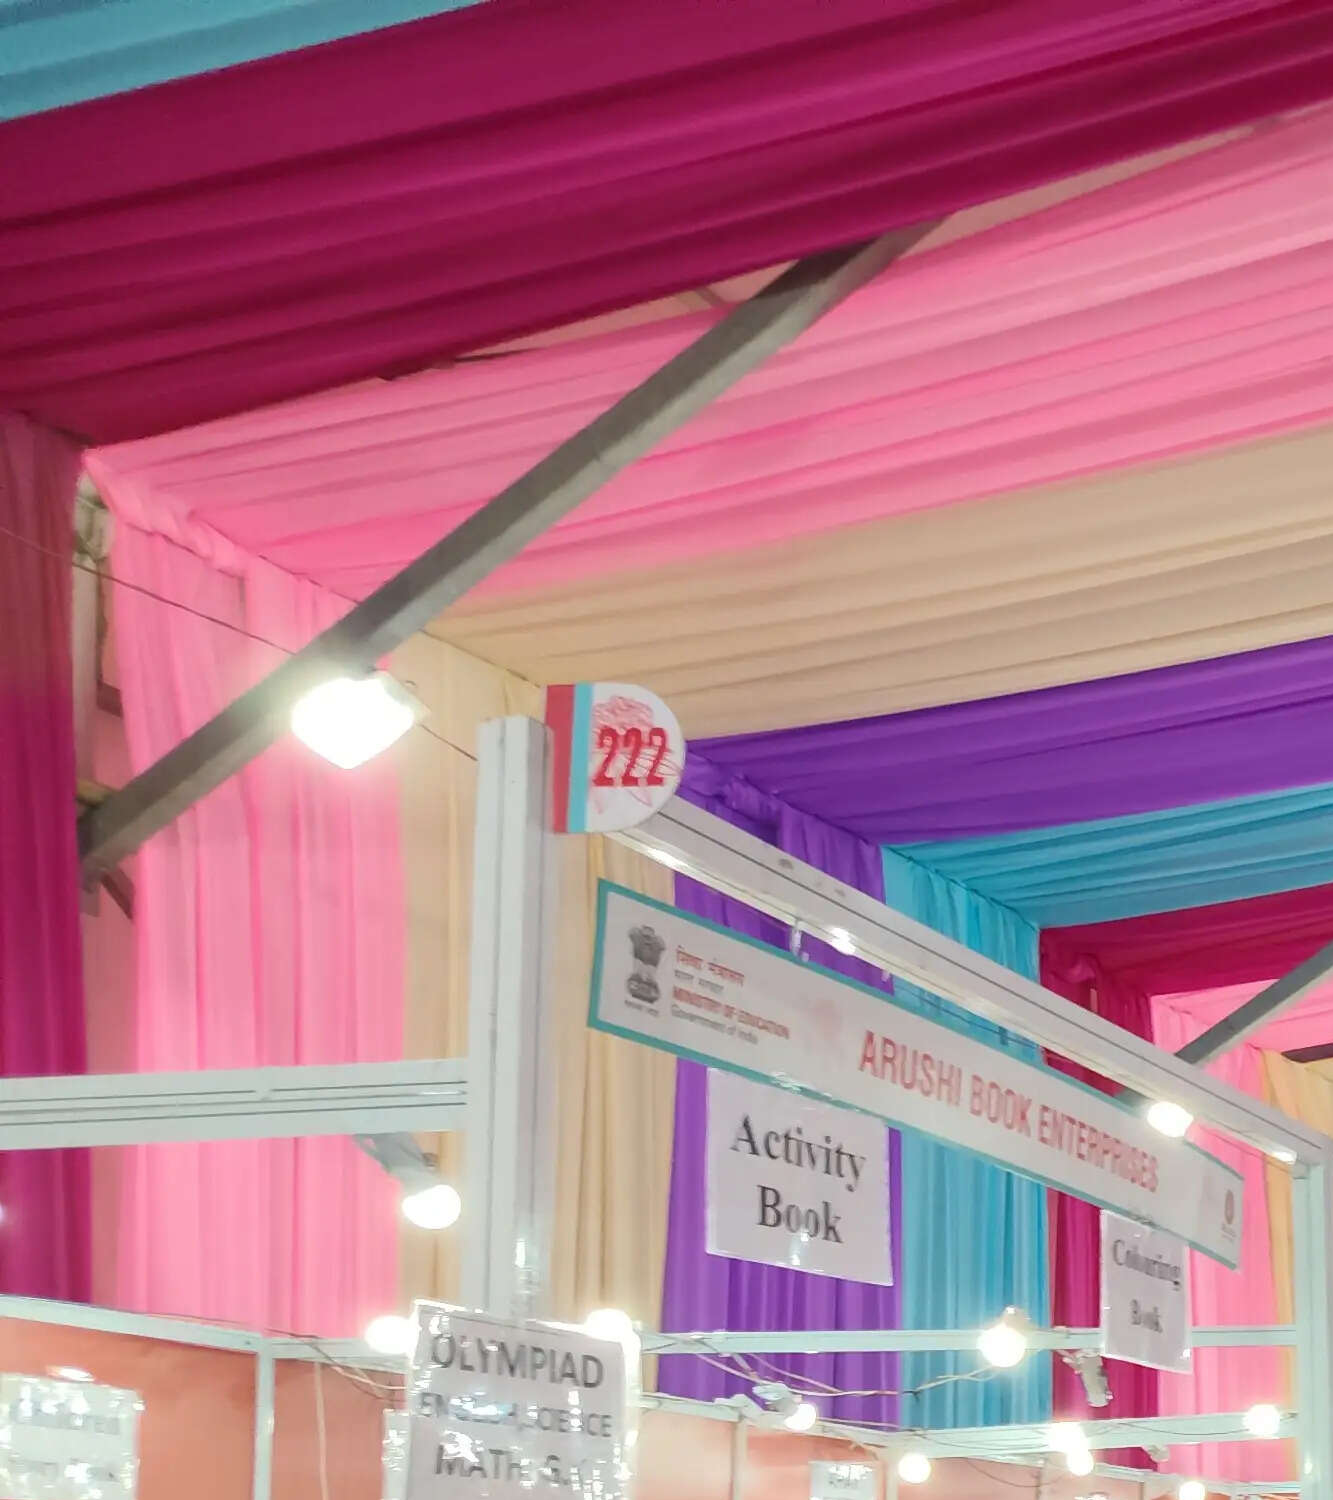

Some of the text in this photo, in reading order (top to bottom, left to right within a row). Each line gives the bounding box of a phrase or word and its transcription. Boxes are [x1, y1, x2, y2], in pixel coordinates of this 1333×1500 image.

[592, 726, 669, 787] 222
[858, 1030, 1160, 1193] ARUSHI BOOK ENTERPRISES
[730, 1113, 867, 1192] Activity
[757, 1185, 844, 1243] Book
[431, 1332, 604, 1388] OLYMPIAD
